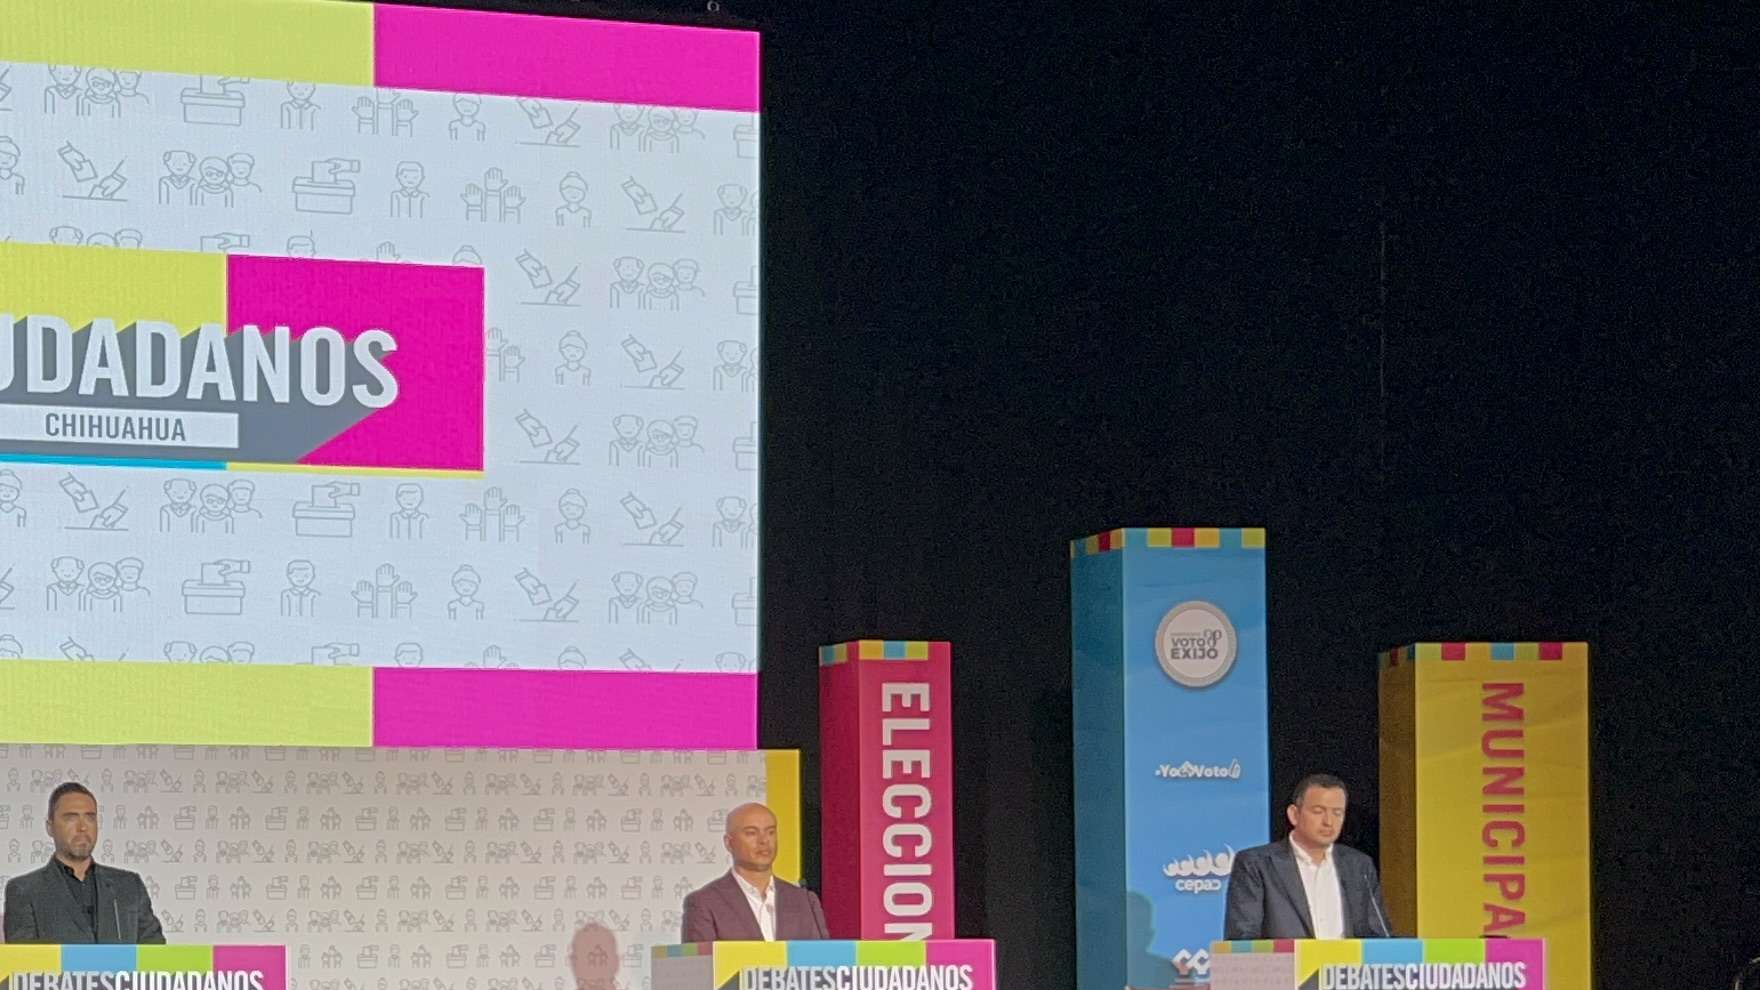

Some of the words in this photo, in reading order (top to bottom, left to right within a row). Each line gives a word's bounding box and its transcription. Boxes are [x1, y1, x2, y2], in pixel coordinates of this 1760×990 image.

[44, 411, 187, 442] CHIHUAHUA
[1171, 637, 1206, 648] VOTO
[1170, 648, 1219, 660] EXIJO
[1323, 961, 1527, 990] DEBATESCIUDADANOS
